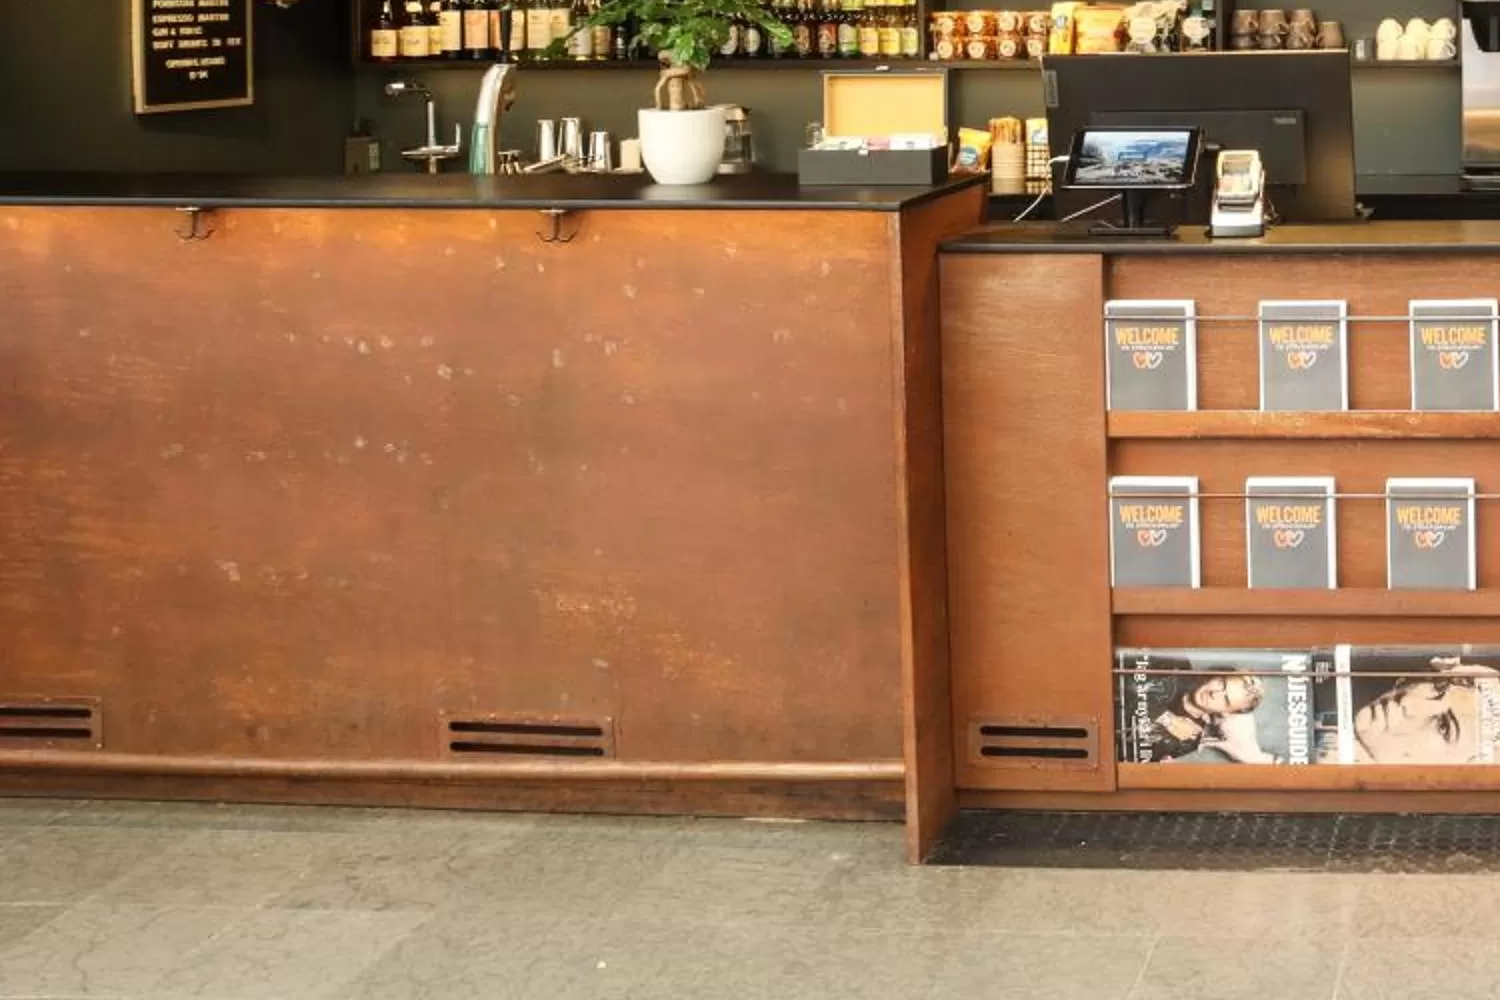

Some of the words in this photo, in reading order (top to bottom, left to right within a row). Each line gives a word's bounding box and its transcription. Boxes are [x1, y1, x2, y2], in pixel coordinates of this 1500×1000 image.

[1116, 327, 1180, 345] WELCOME
[1269, 326, 1333, 344] WELCOME
[1421, 326, 1487, 345] WELCOME
[1119, 504, 1184, 524] WELCOME
[1256, 505, 1321, 524] WELCOME
[1396, 506, 1462, 525] WELCOME
